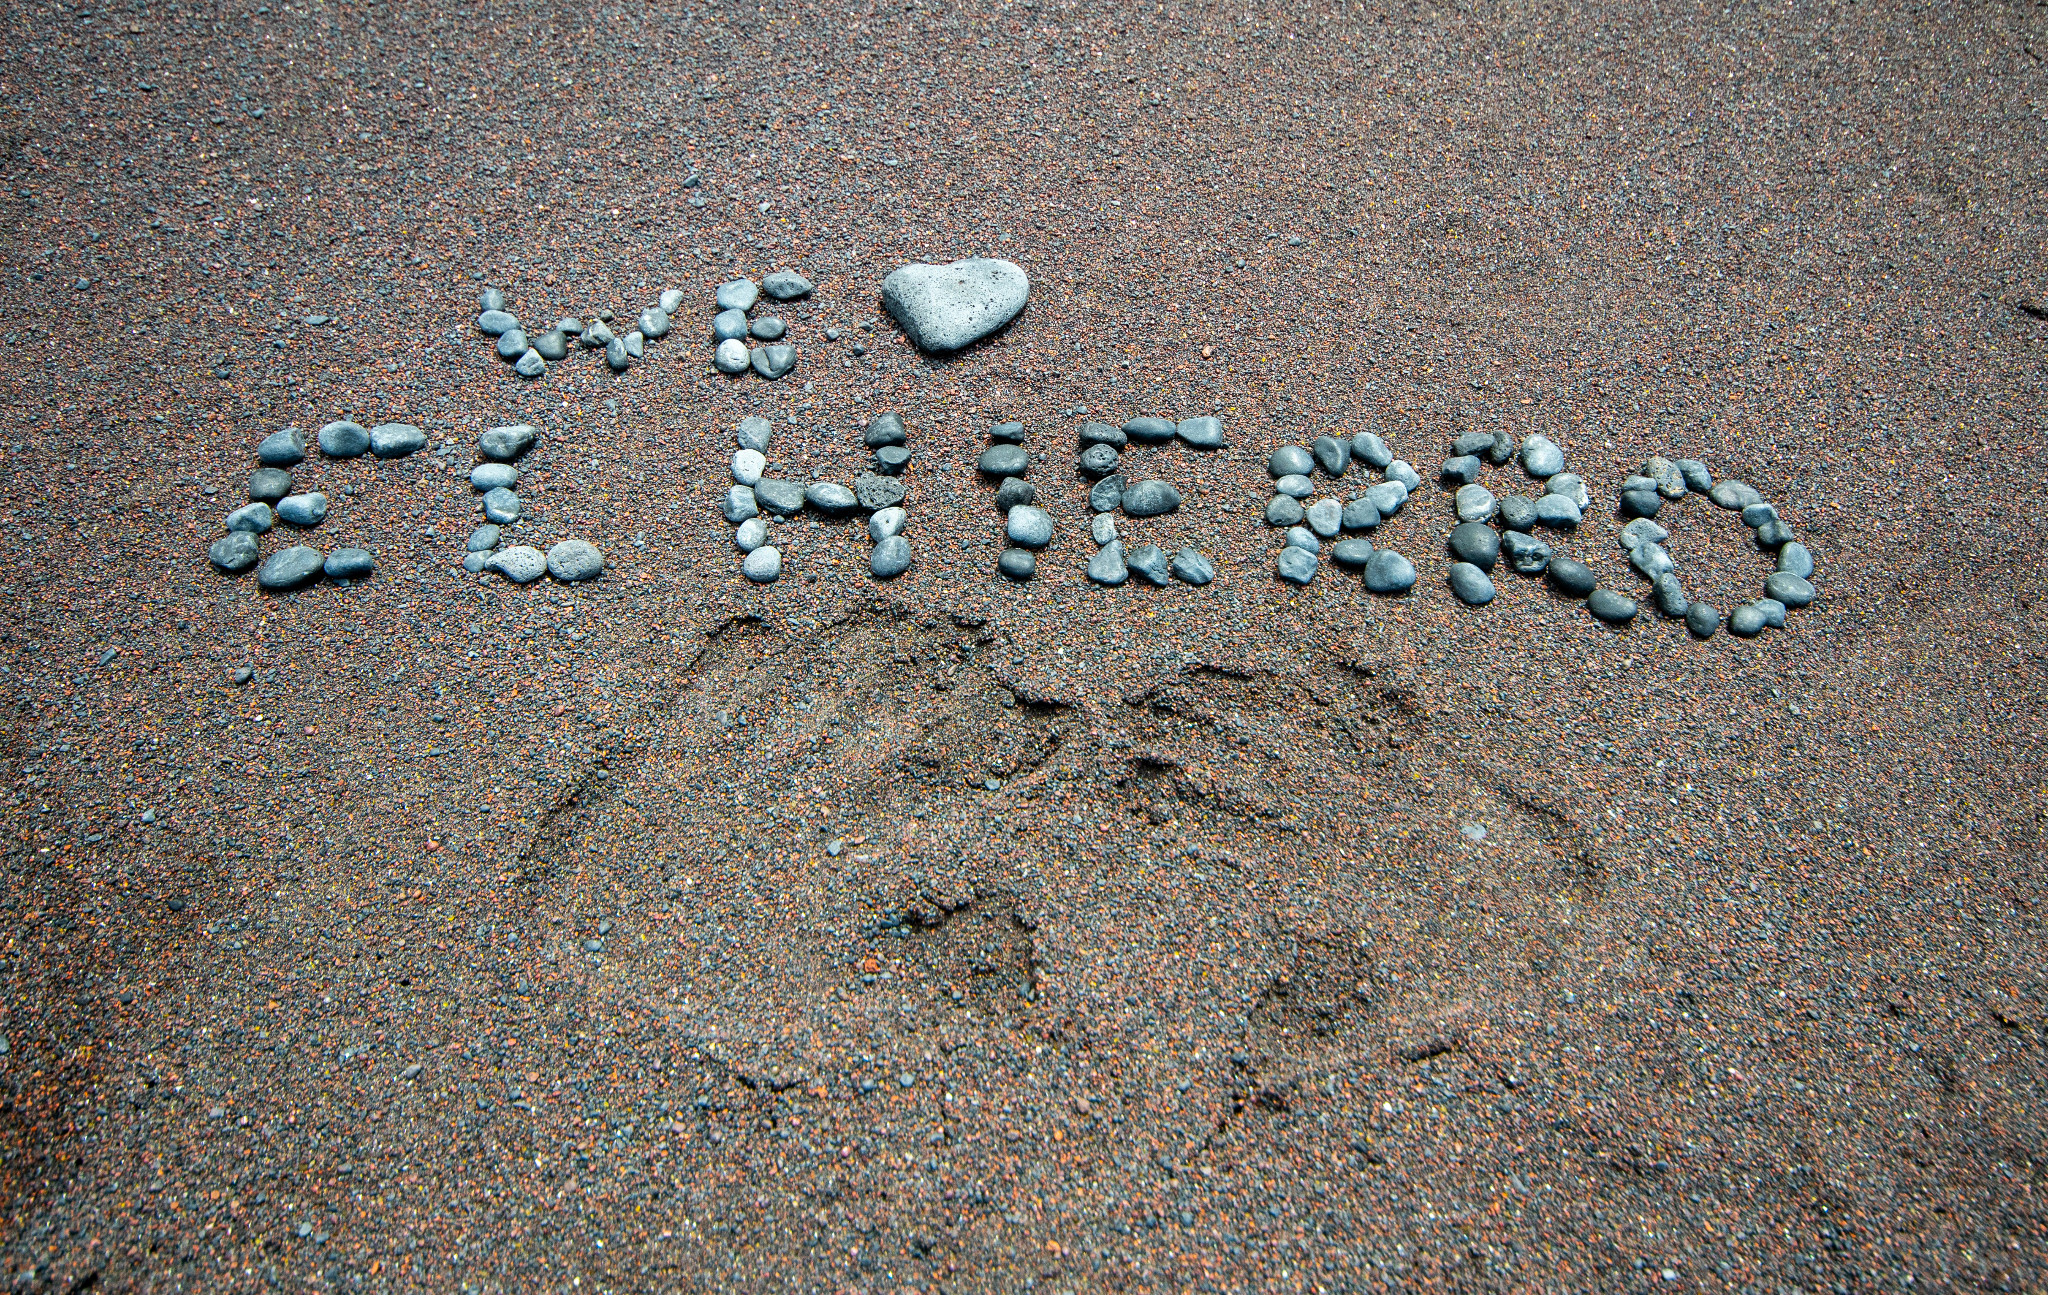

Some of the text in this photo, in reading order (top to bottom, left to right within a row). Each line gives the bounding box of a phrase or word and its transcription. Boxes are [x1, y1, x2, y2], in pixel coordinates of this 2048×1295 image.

[478, 271, 812, 380] WE
[208, 412, 1816, 637] EL HIERRO
